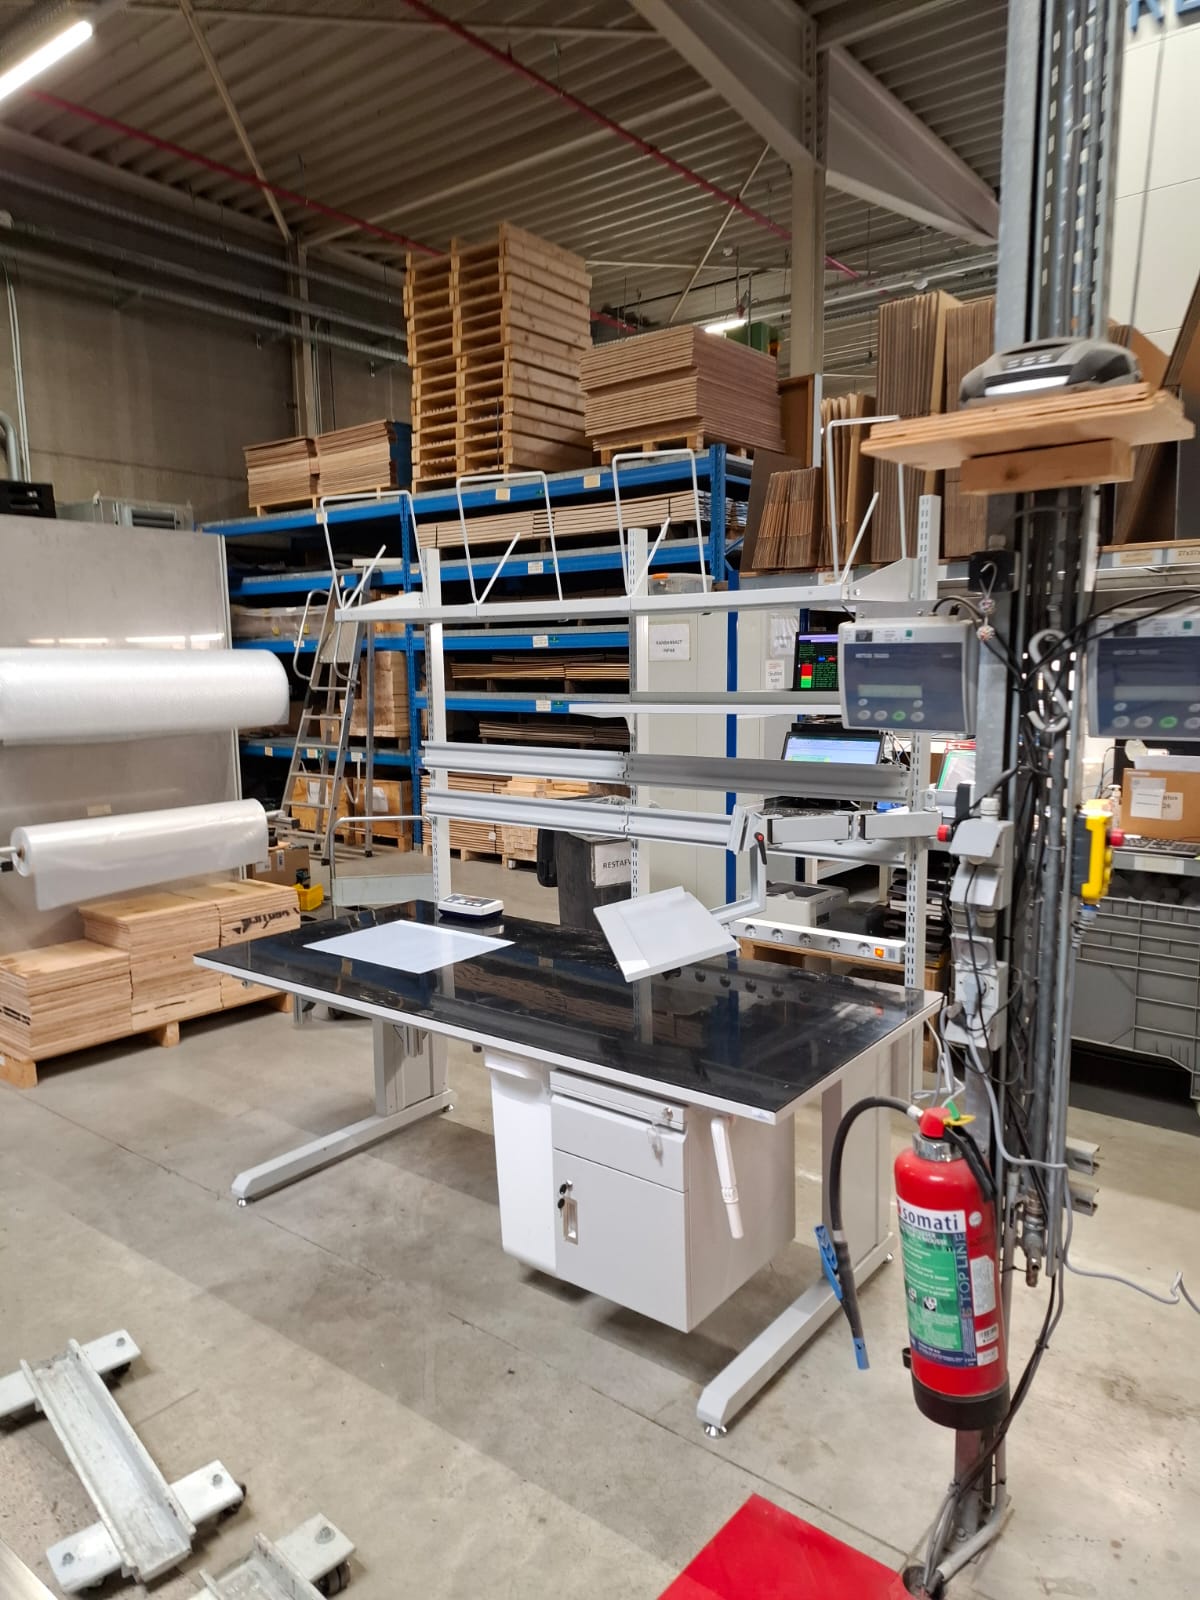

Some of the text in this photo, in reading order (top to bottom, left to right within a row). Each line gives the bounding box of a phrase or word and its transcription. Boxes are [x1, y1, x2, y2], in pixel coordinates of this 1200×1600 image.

[902, 1207, 959, 1231] somati
[954, 1232, 968, 1268] LINE
[959, 1272, 970, 1306] TOP
